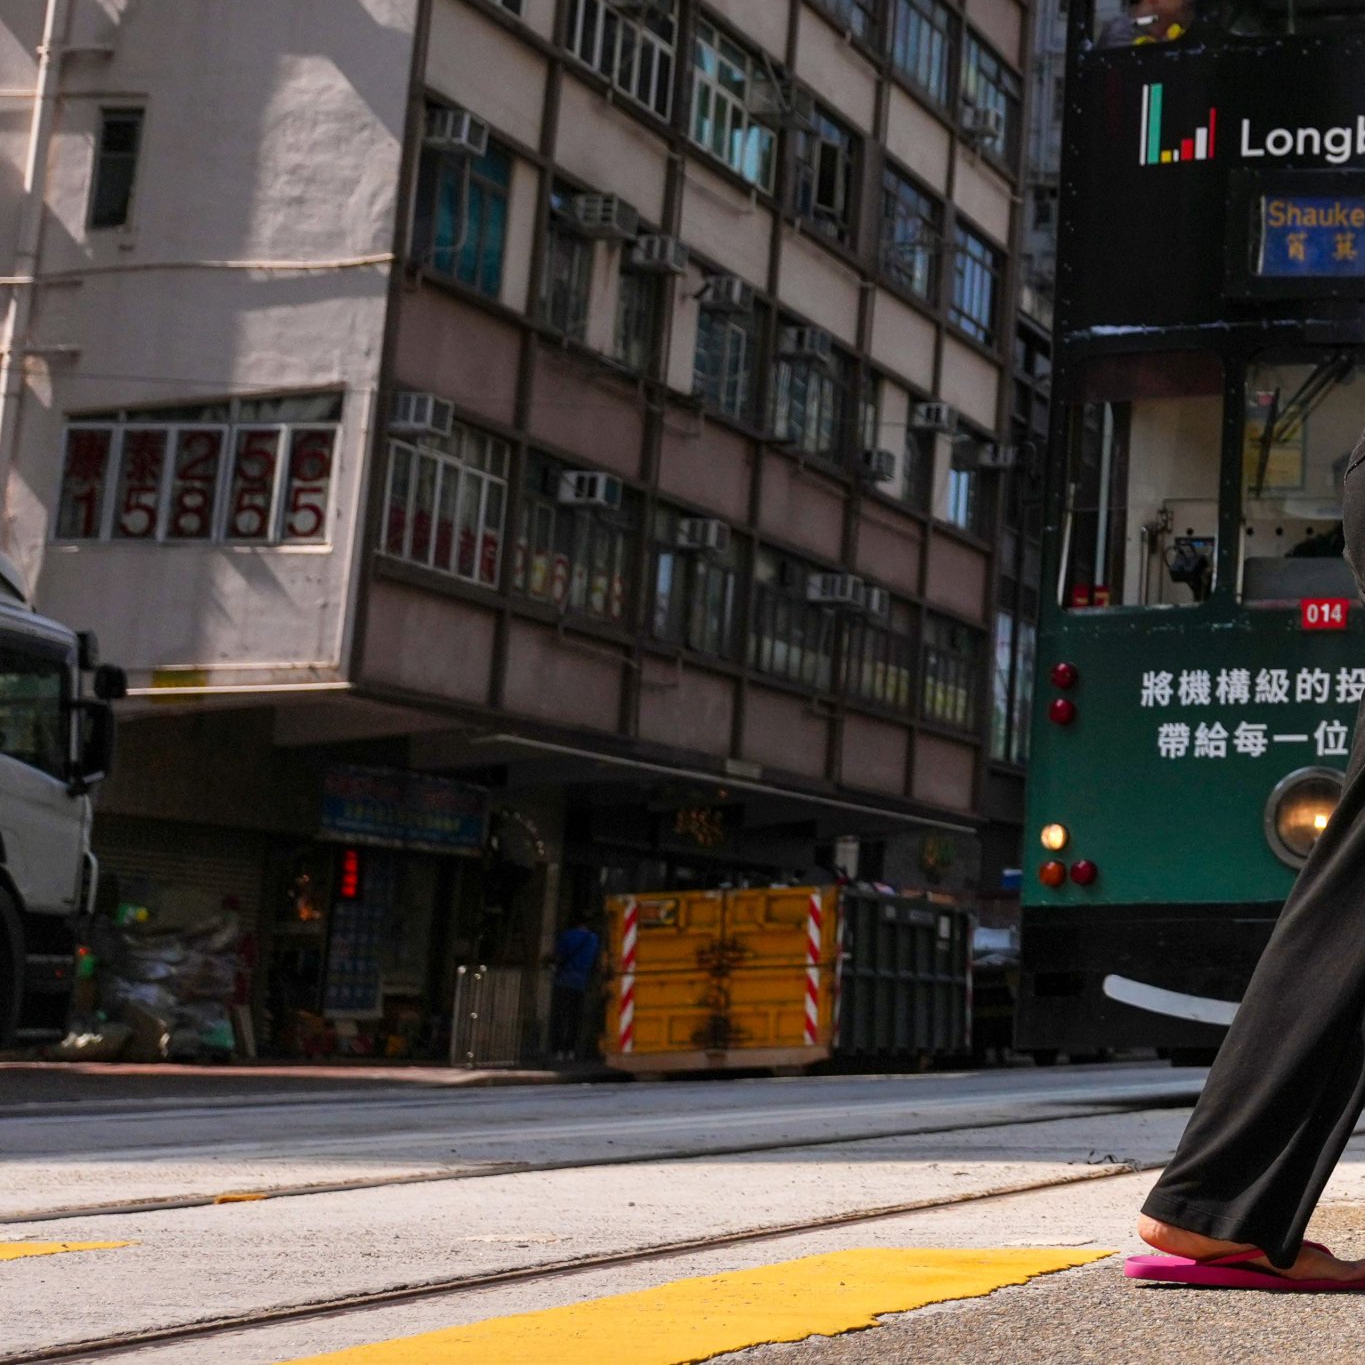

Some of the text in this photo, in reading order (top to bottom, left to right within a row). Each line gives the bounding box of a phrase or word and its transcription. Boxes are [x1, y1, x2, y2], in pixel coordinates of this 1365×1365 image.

[1306, 603, 1343, 623] 014
[1157, 719, 1349, 759] 帶給每一位
